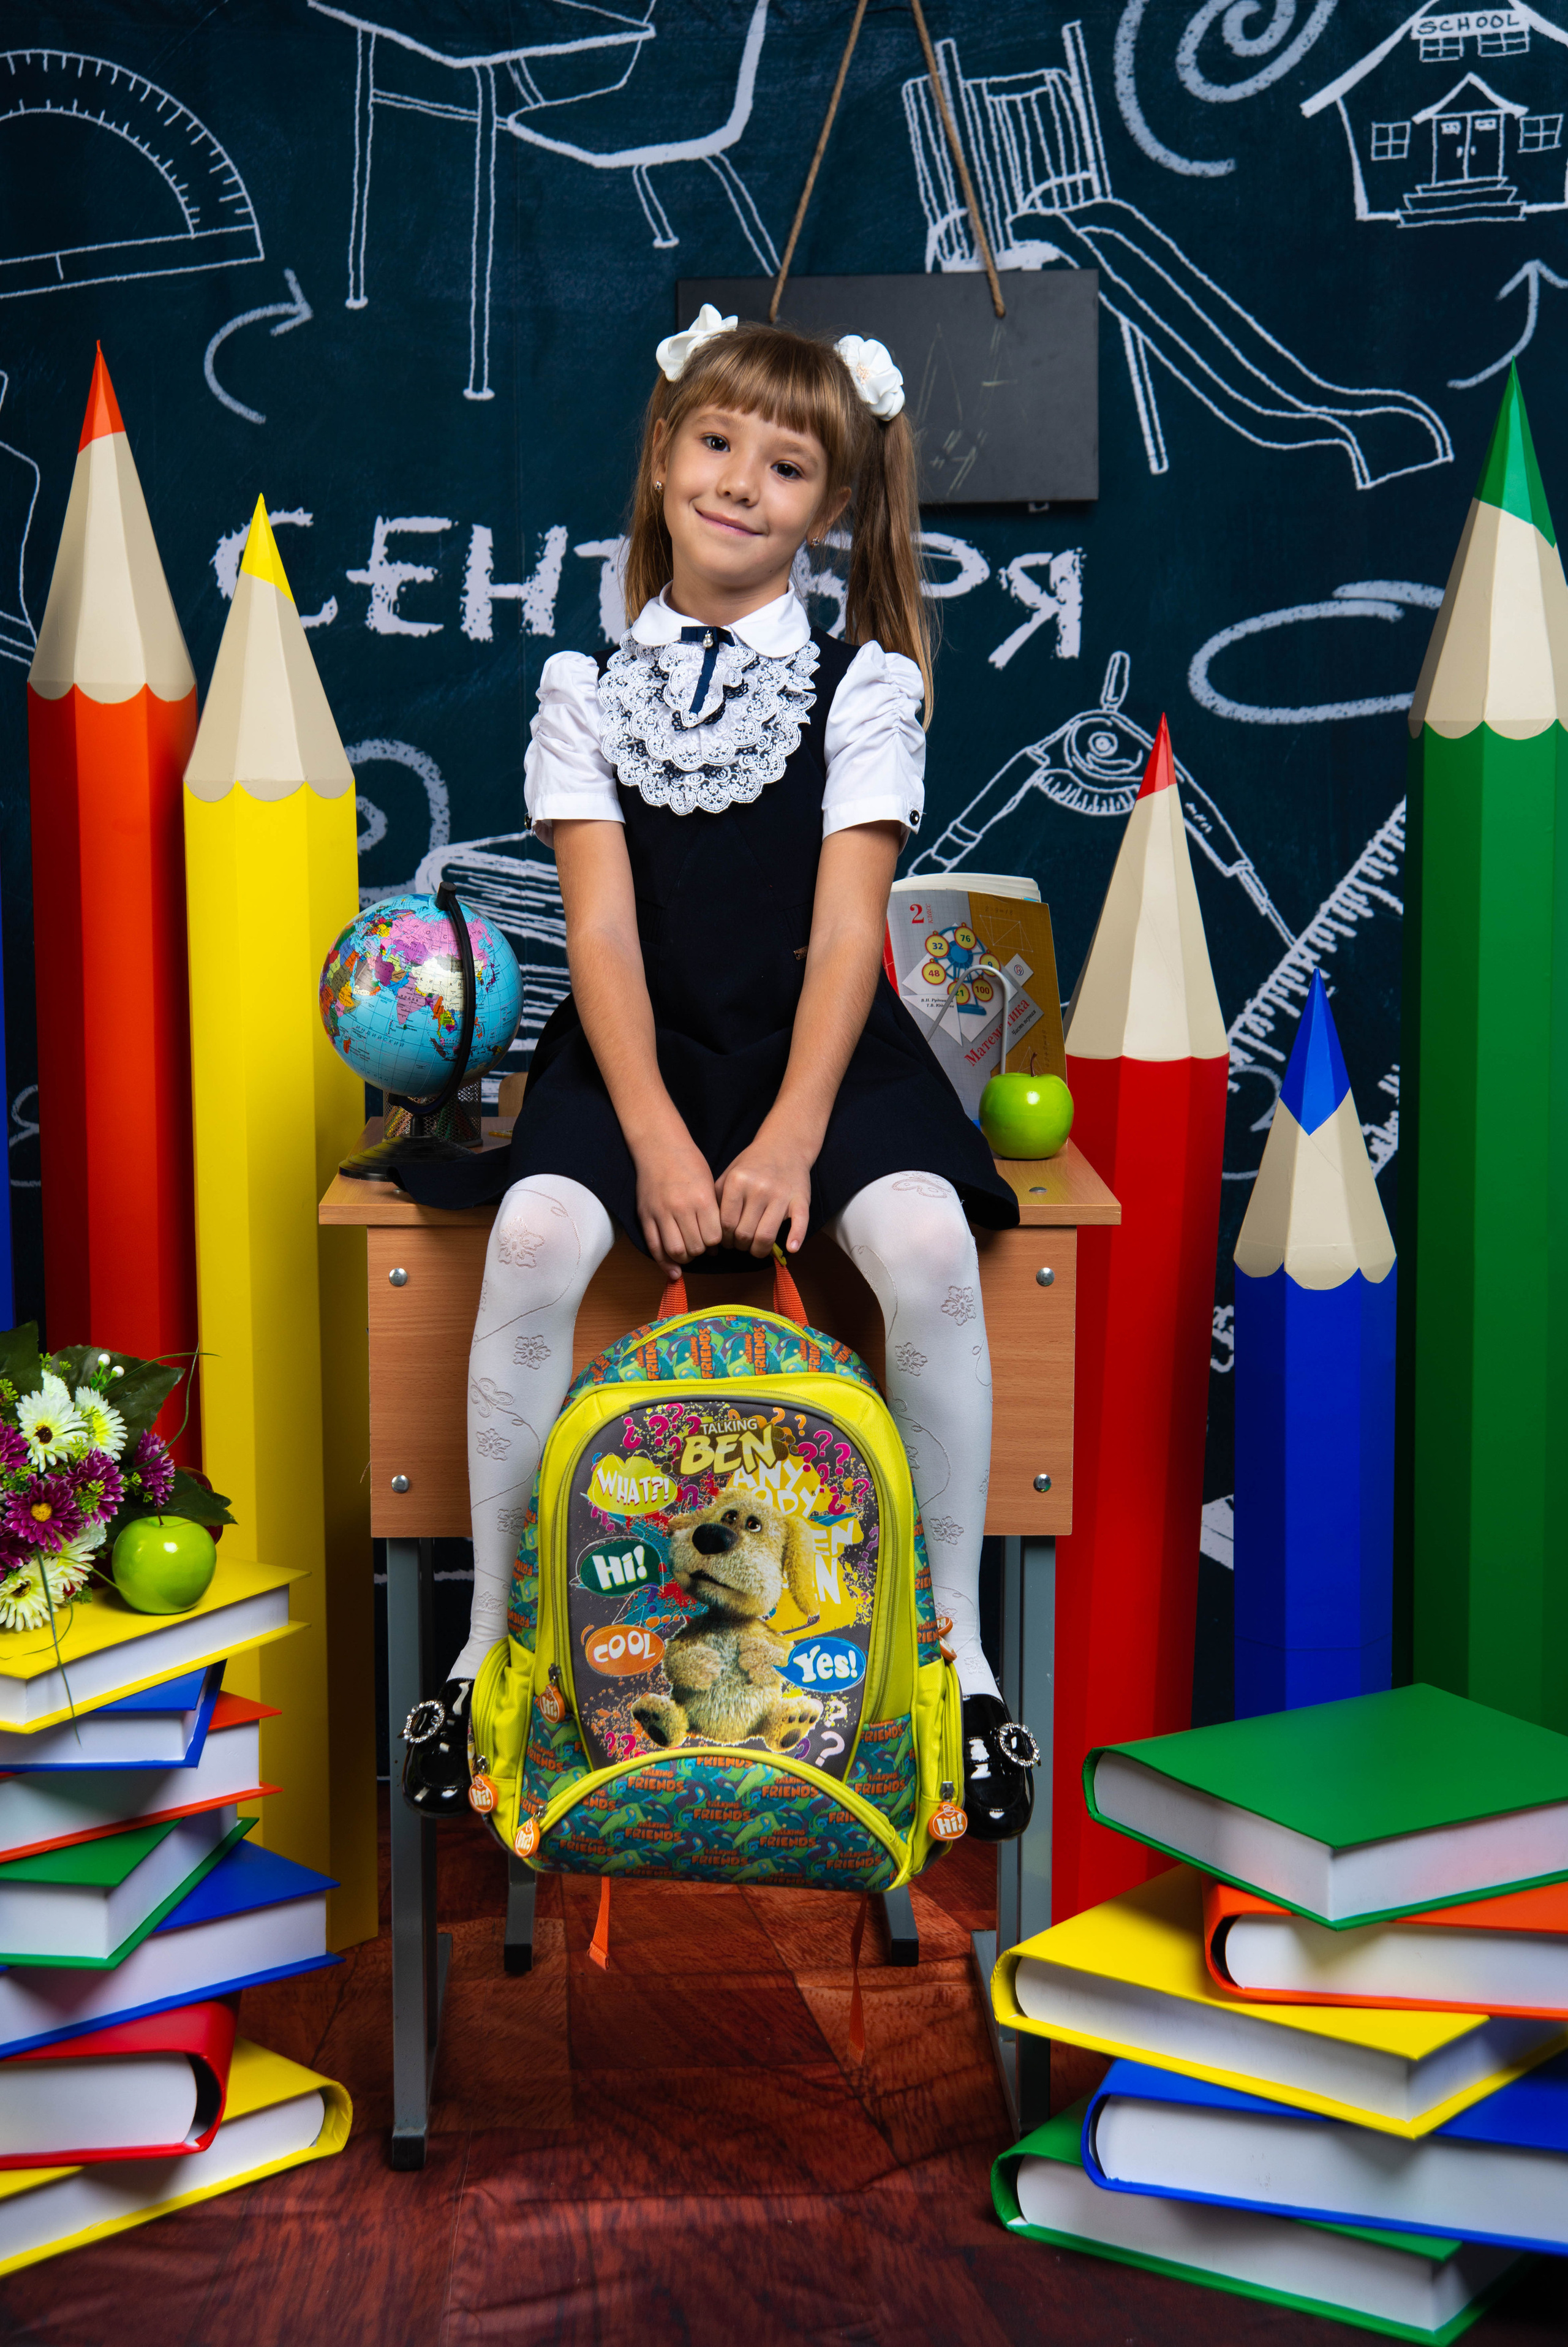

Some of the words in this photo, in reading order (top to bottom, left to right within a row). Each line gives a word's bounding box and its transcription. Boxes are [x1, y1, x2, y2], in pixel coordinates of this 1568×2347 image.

[1416, 13, 1520, 35] SCHOOL
[910, 904, 924, 924] 2
[960, 934, 971, 943] 76
[420, 977, 462, 987] КИТАЙ
[975, 985, 990, 994] 100
[1012, 1023, 1025, 1035] Часть
[1023, 1009, 1036, 1024] первая
[356, 1025, 405, 1047] ИНДИЙСКИЙ
[698, 1328, 713, 1378] FRIENDS
[753, 1326, 767, 1375] FRIENDS
[701, 1418, 758, 1435] TALKING
[680, 1424, 776, 1475] BEN
[733, 1460, 807, 1489] ANY
[596, 1468, 669, 1506] WHAT?!
[752, 1484, 821, 1518] ODY
[592, 1545, 647, 1590] Hi!
[594, 1630, 656, 1663] COOL
[793, 1645, 858, 1683] Yes!
[696, 1756, 753, 1769] FRIENDS
[627, 1776, 685, 1793] FRIENDS
[762, 1785, 819, 1799] FRIENDS
[855, 1779, 905, 1794] FRIENDS
[471, 1788, 491, 1807] Hi!
[693, 1808, 751, 1822] FRIENDS
[937, 1813, 963, 1835] Hi!
[625, 1827, 682, 1842] FRIENDS
[760, 1836, 816, 1848] FRIENDS
[560, 1839, 615, 1856] FRIENDS
[692, 1854, 749, 1866] FRIENDS
[826, 1855, 883, 1869] FRIENDS
